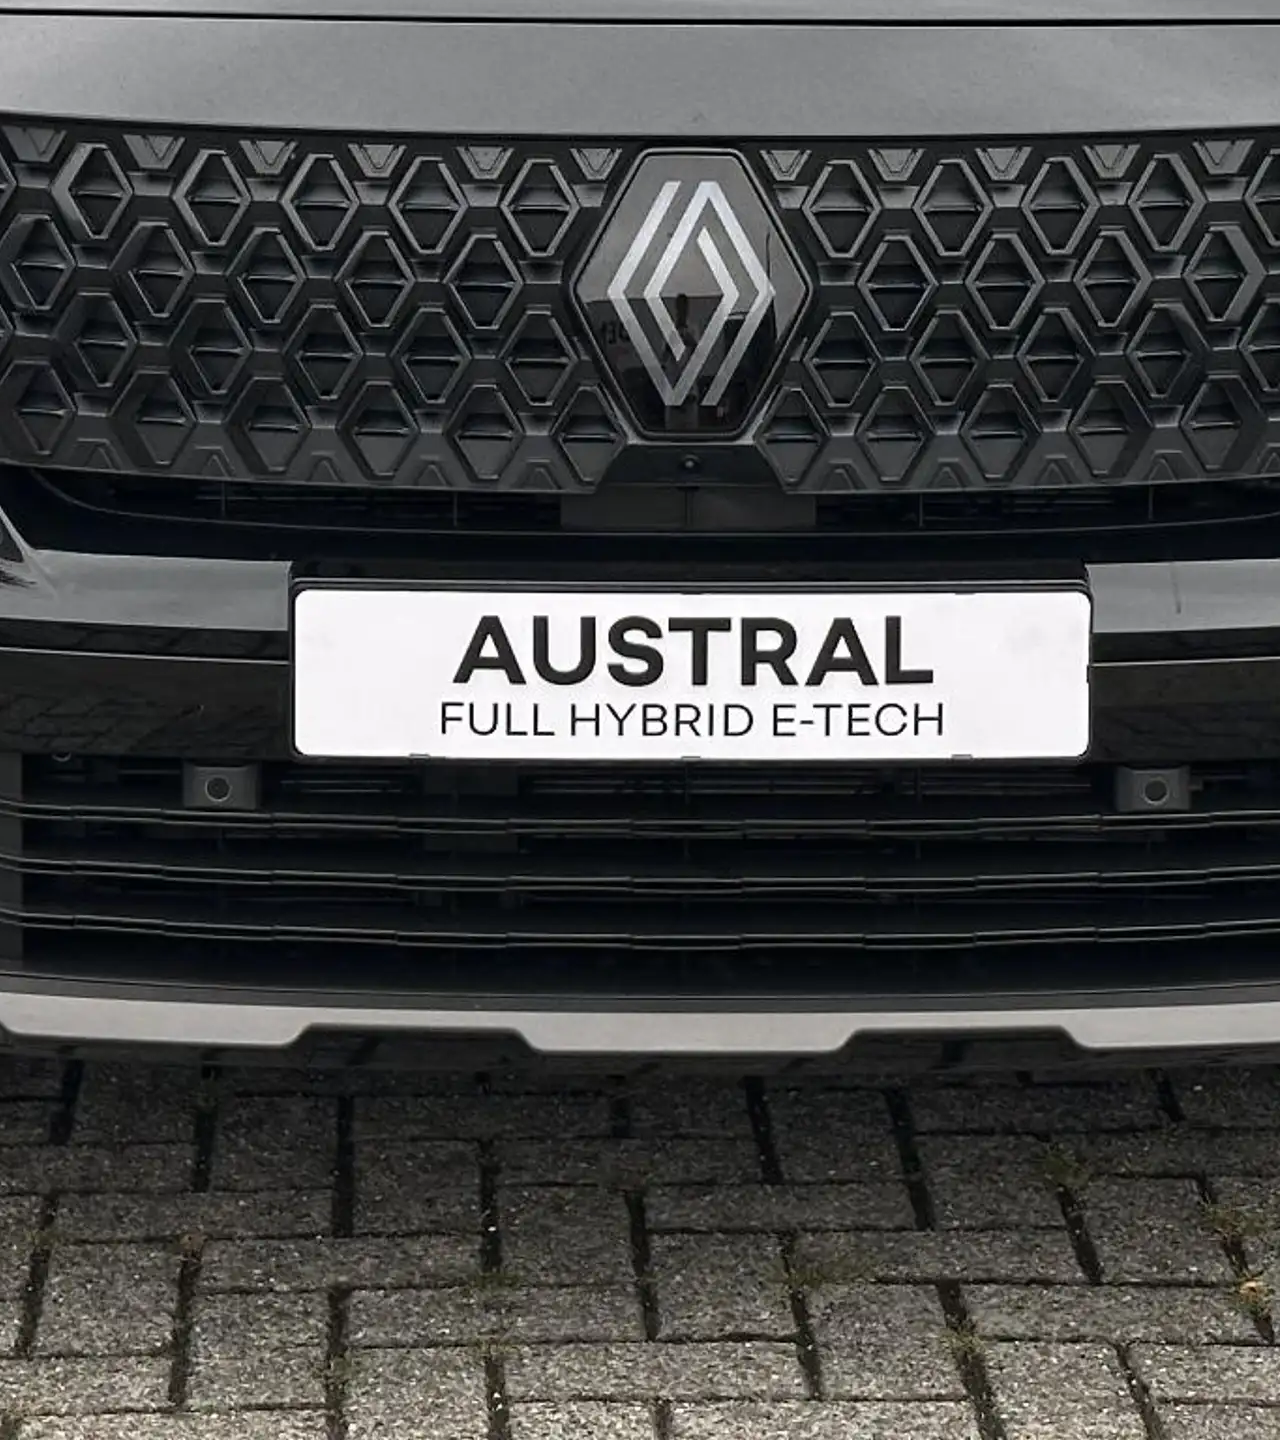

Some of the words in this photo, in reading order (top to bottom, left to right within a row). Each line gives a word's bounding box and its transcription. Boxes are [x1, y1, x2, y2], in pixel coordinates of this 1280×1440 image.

[452, 615, 935, 688] AUSTRAL
[440, 702, 556, 738] FULL
[570, 702, 756, 739] HYBRID
[771, 702, 945, 739] E-TECH
